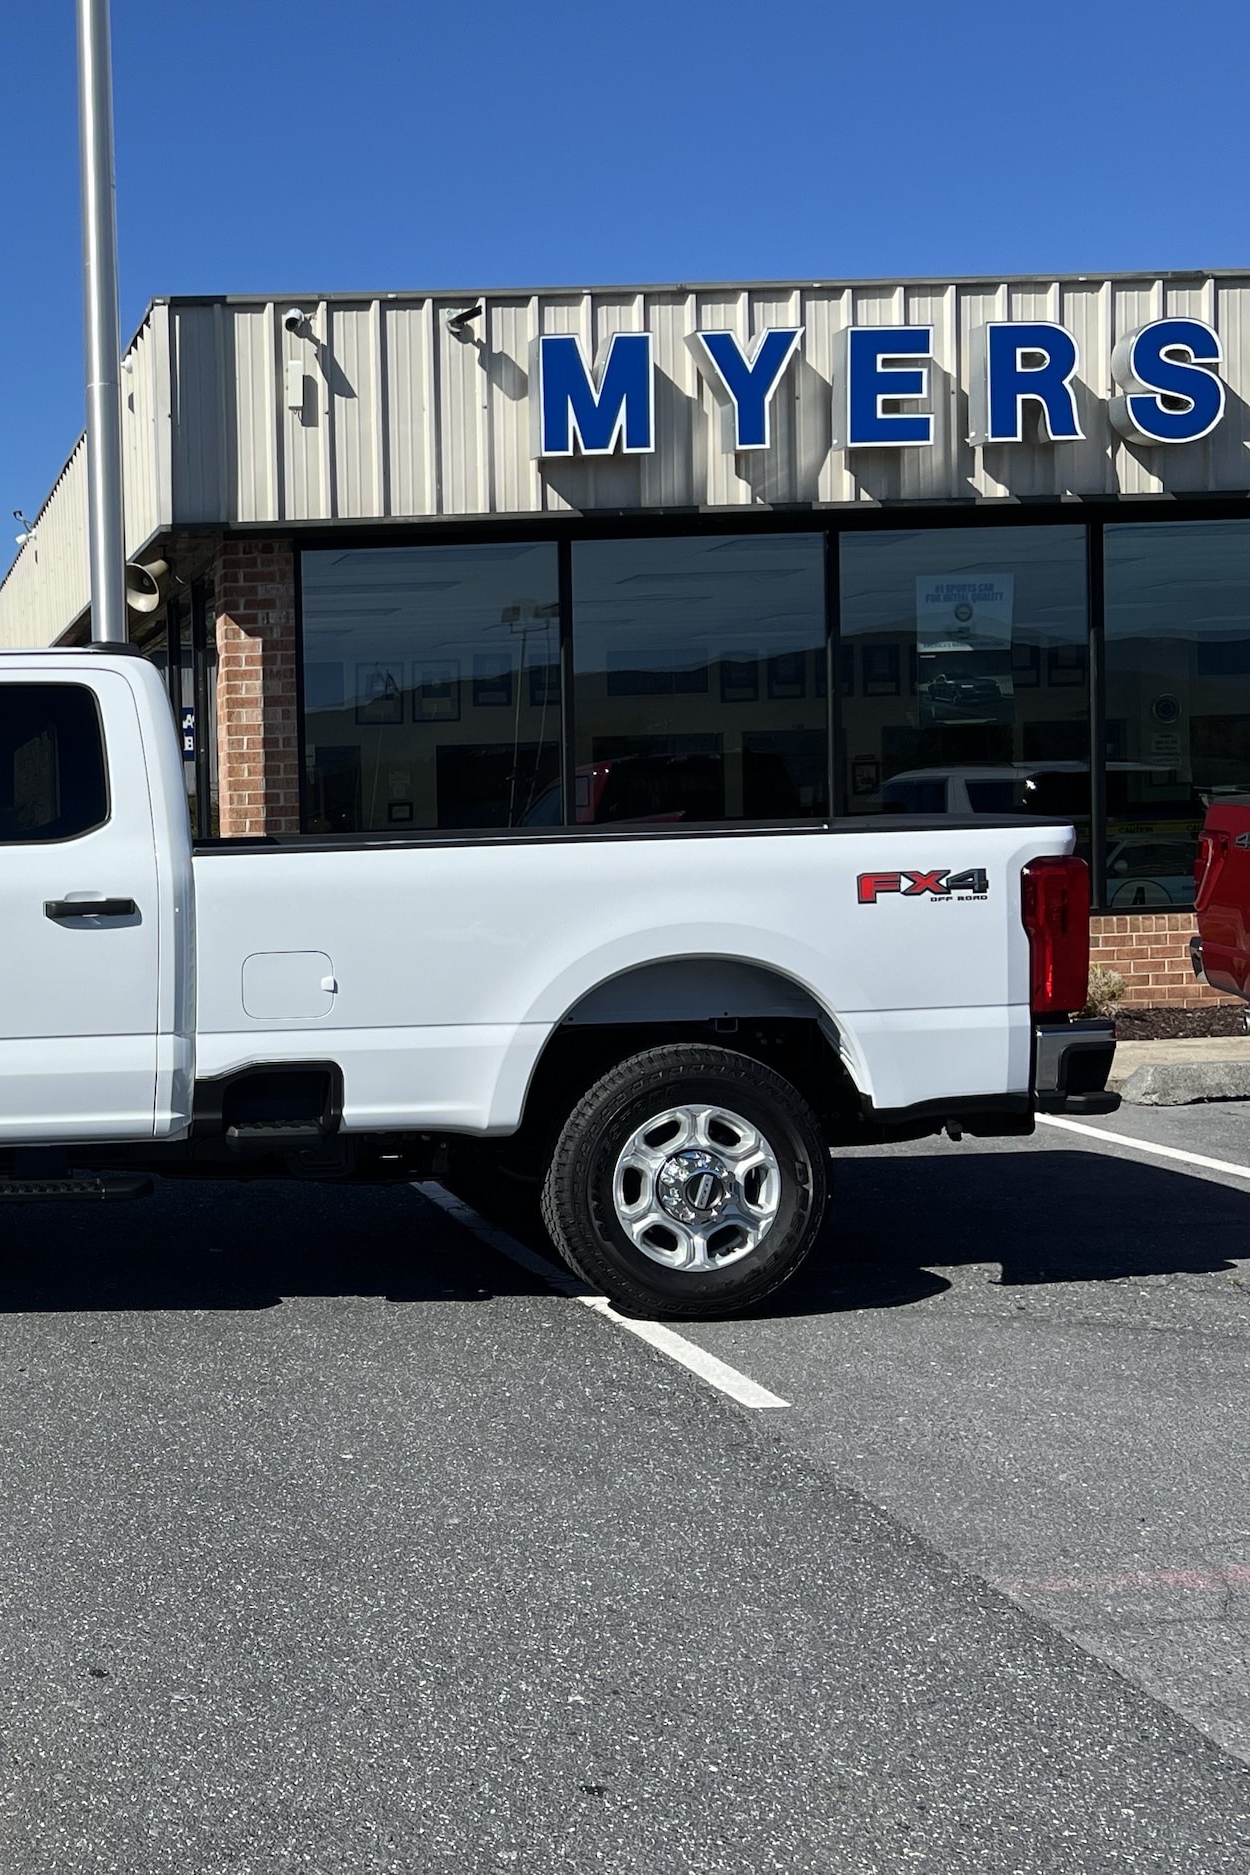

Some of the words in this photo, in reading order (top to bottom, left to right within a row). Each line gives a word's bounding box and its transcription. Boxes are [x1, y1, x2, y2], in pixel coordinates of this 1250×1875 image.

[536, 317, 1225, 457] MYERS
[1118, 824, 1154, 834] CAUTION
[856, 867, 989, 904] FX4
